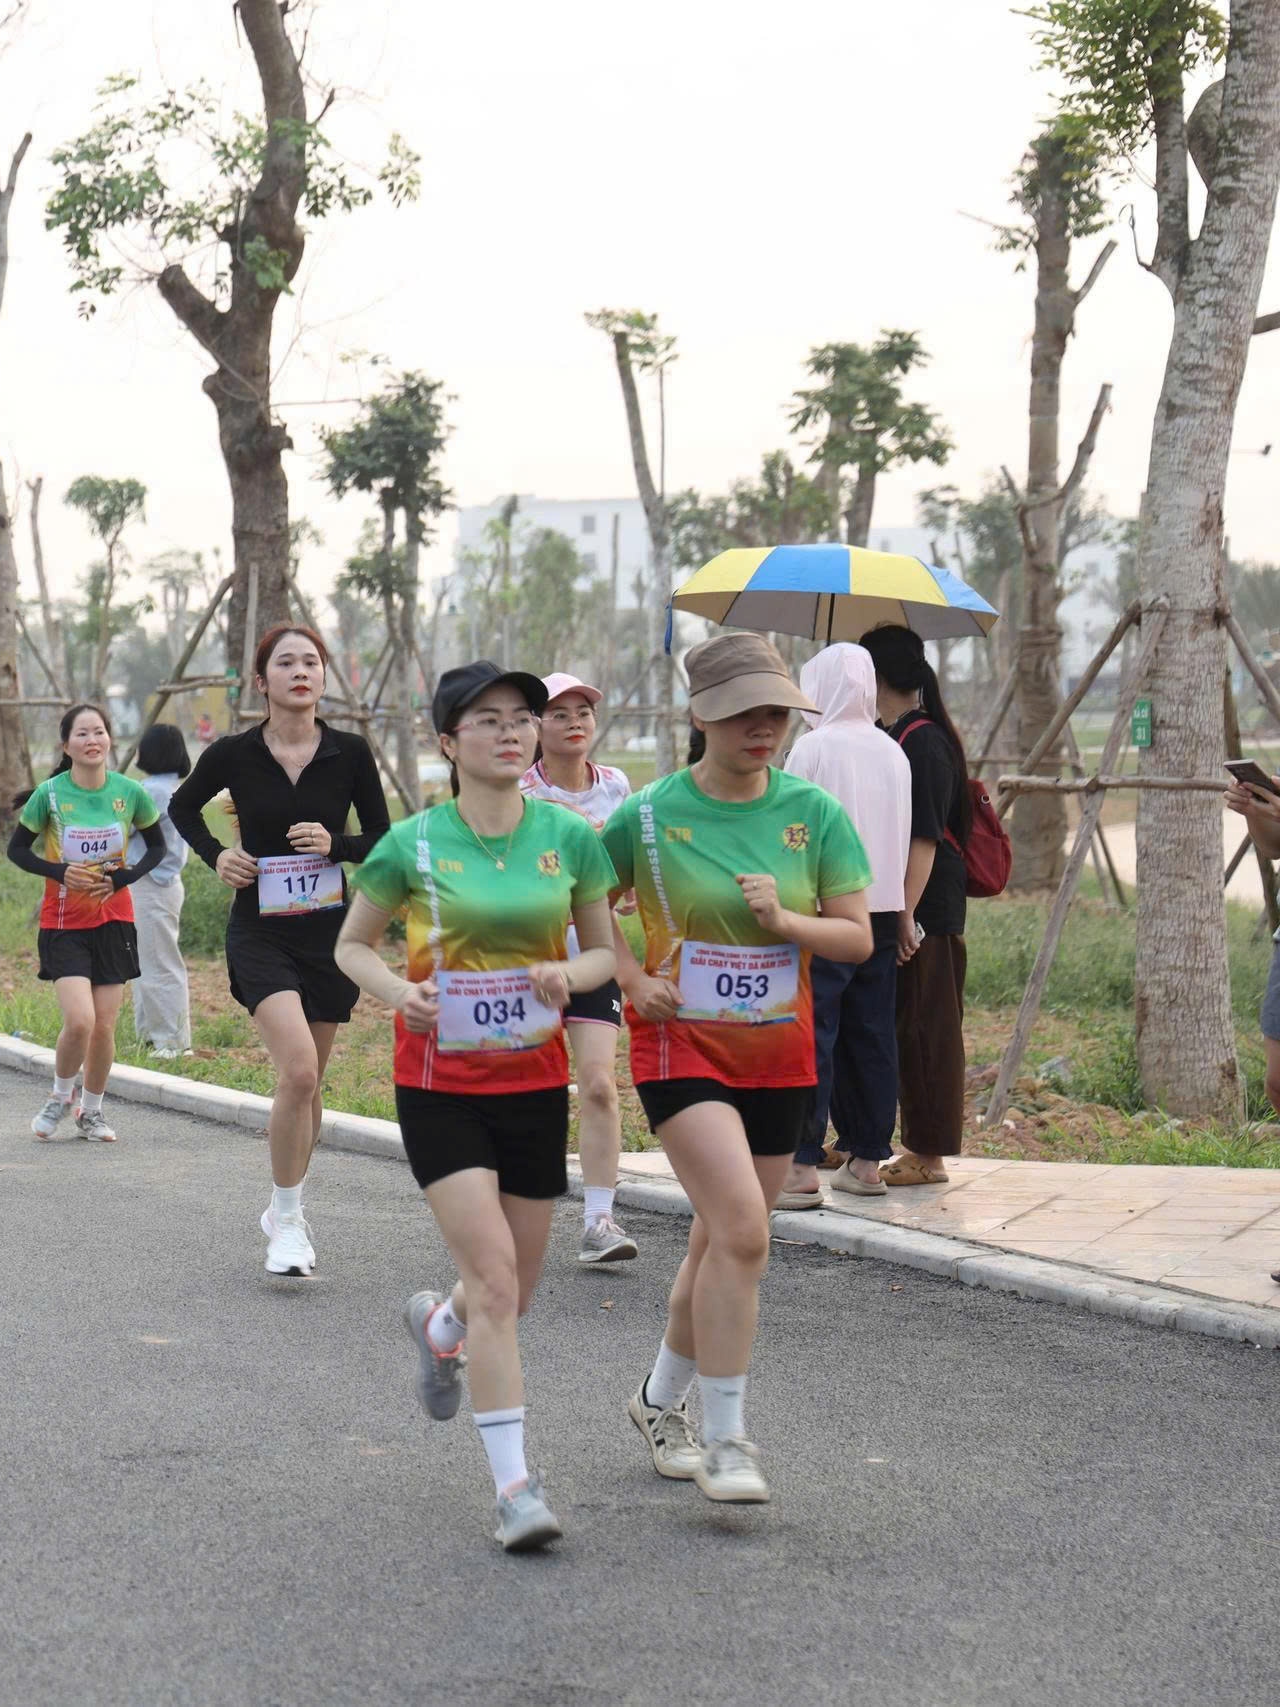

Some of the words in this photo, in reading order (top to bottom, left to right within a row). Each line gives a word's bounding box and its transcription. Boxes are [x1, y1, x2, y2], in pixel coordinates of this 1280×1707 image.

[639, 803, 656, 844] Race
[81, 840, 107, 854] 044
[284, 873, 320, 894] 117
[716, 973, 769, 998] 053
[473, 997, 526, 1025] 034
